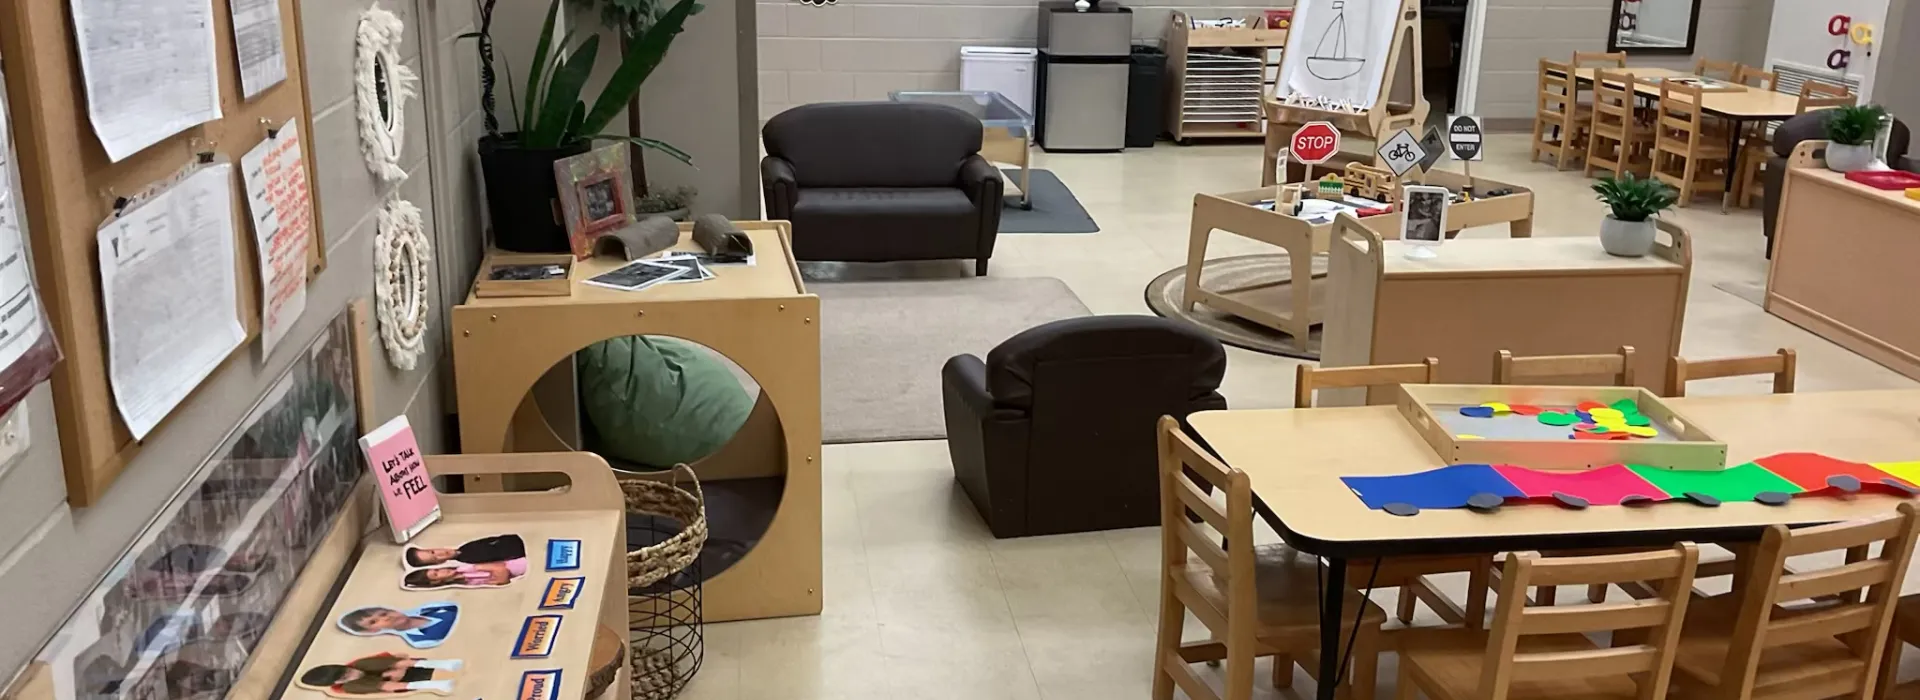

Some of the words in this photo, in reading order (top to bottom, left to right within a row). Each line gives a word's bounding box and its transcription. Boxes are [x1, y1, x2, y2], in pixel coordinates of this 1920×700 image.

[1297, 136, 1334, 150] STOP
[1455, 143, 1475, 151] ENTER
[398, 447, 415, 461] TALK
[390, 466, 409, 486] ABOUT
[409, 459, 420, 472] HOW
[403, 475, 428, 500] FEEL
[556, 545, 573, 564] Happy
[551, 582, 575, 602] Angry
[525, 621, 549, 652] Worried
